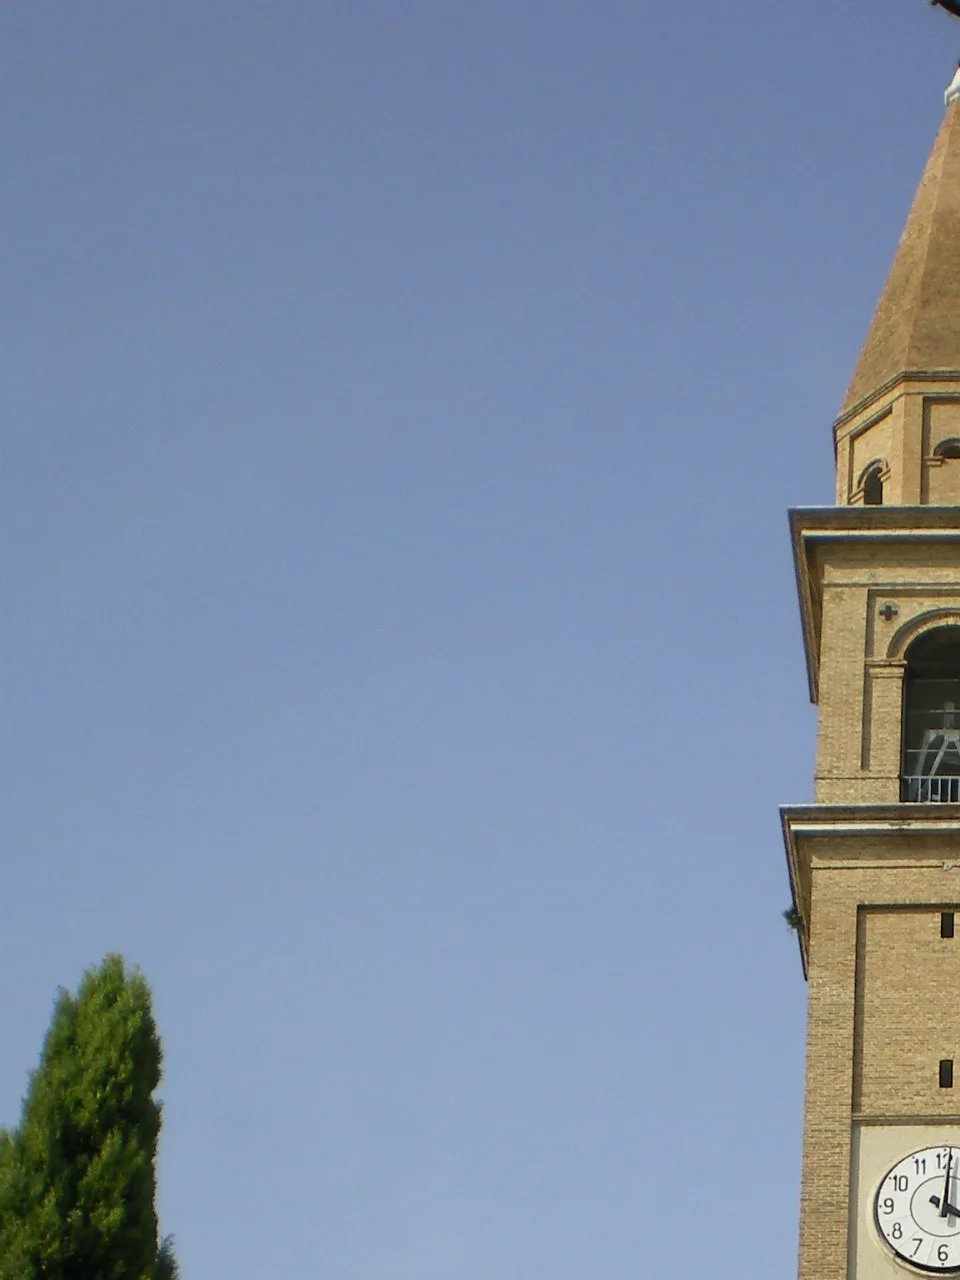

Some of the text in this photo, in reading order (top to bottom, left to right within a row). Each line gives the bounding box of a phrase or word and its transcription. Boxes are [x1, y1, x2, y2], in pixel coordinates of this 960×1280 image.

[914, 1158, 926, 1175] 11
[893, 1175, 908, 1192] 10
[883, 1198, 894, 1215] 9
[892, 1222, 903, 1239] 8
[912, 1238, 923, 1256] 7
[938, 1244, 949, 1261] 6
